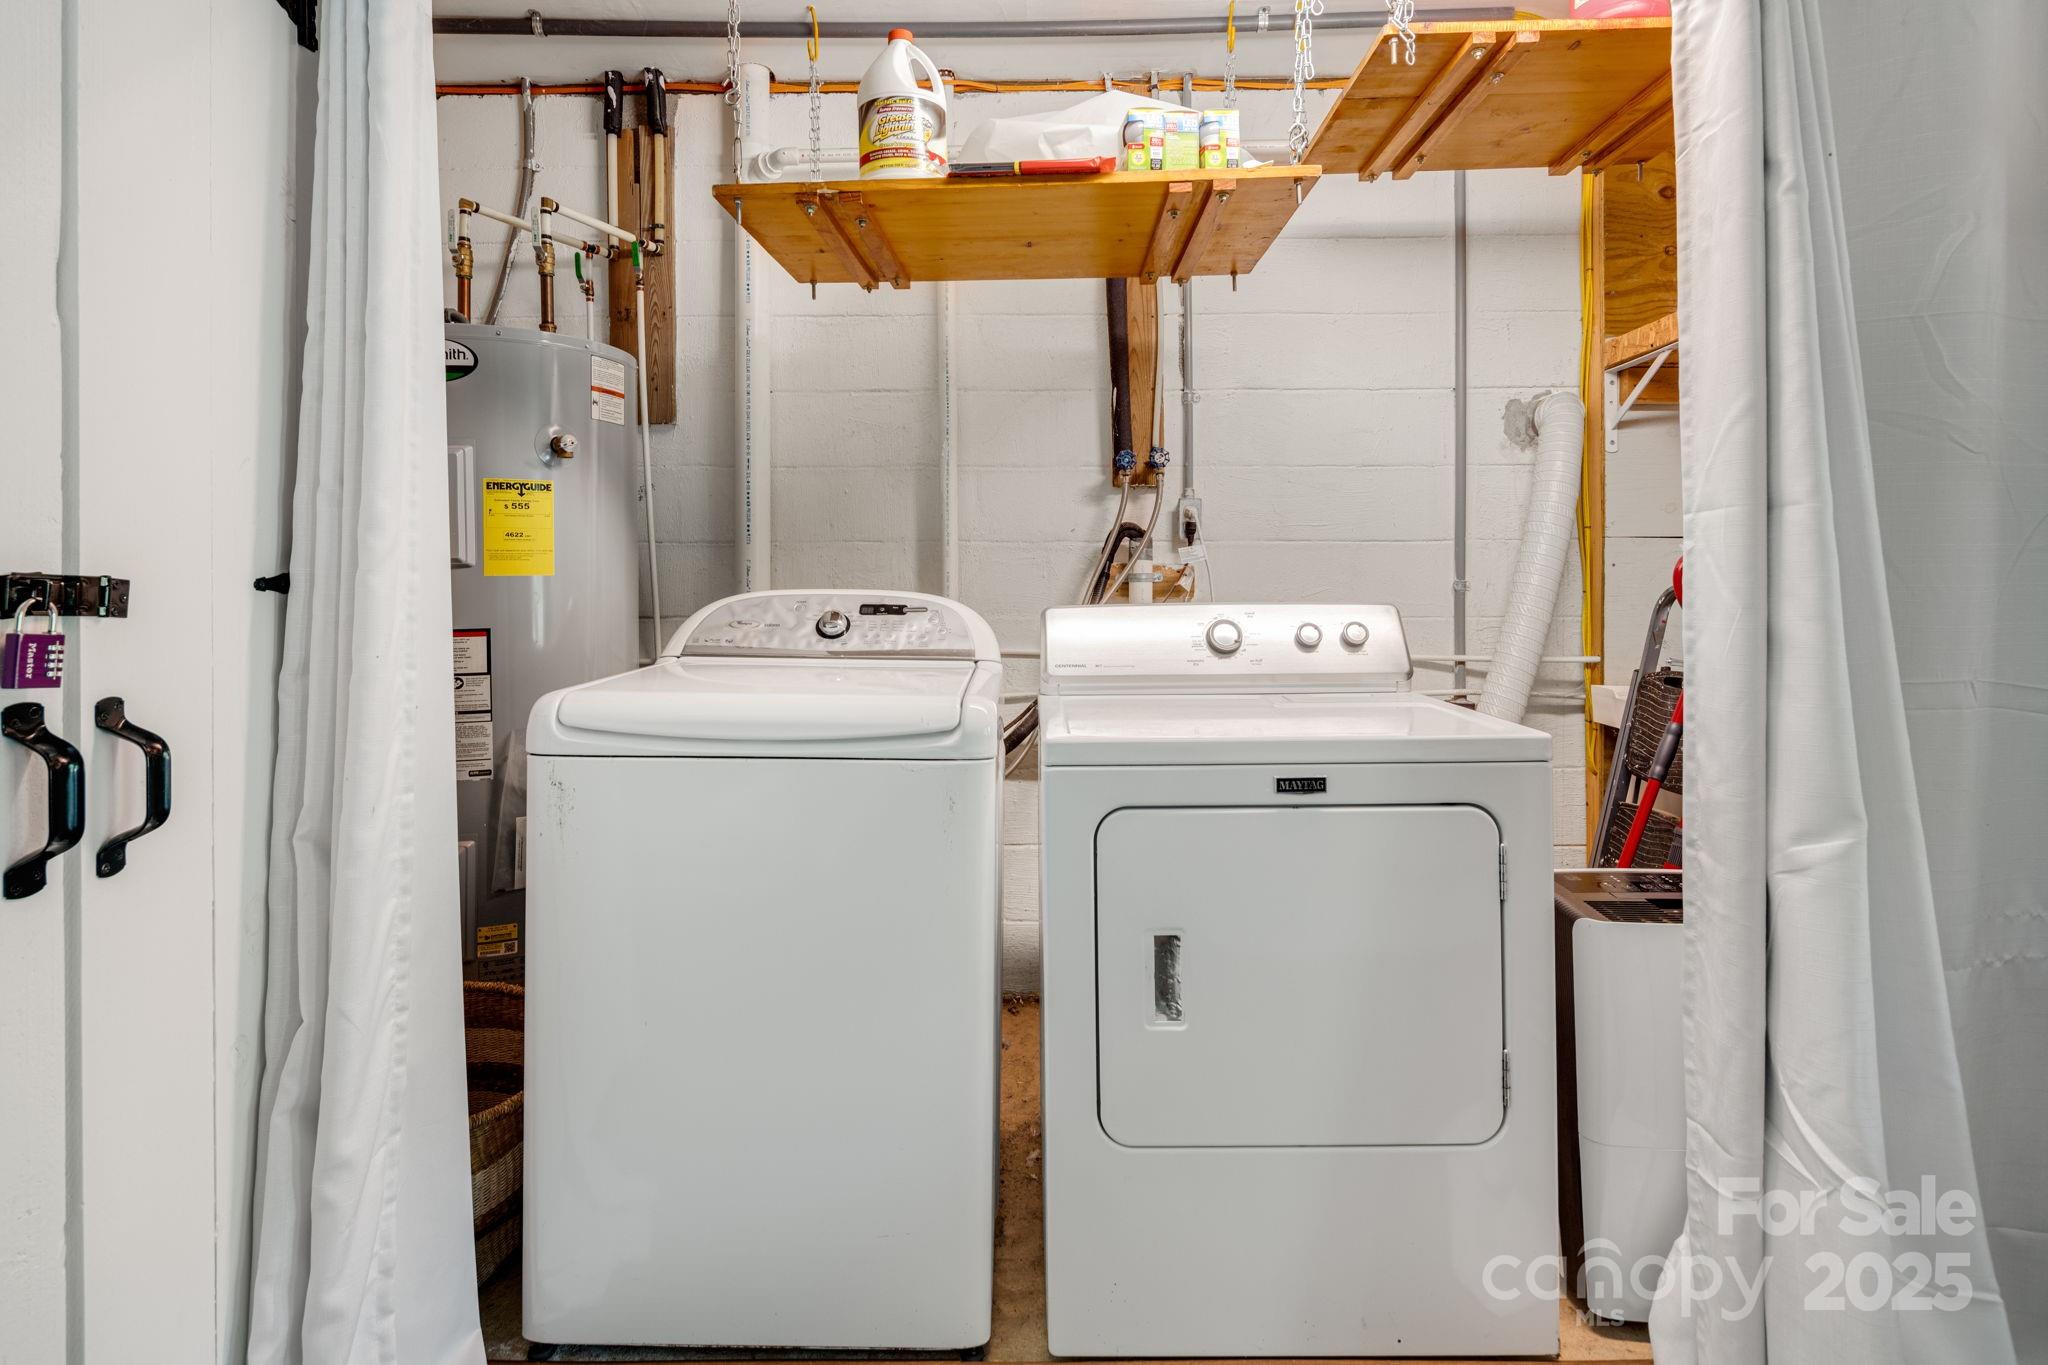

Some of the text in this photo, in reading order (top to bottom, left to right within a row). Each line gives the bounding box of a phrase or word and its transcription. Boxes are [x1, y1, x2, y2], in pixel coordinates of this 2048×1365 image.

[486, 481, 552, 492] ENERGYGUIDE
[25, 642, 37, 679] Master
[1279, 780, 1324, 790] MAYTAG
